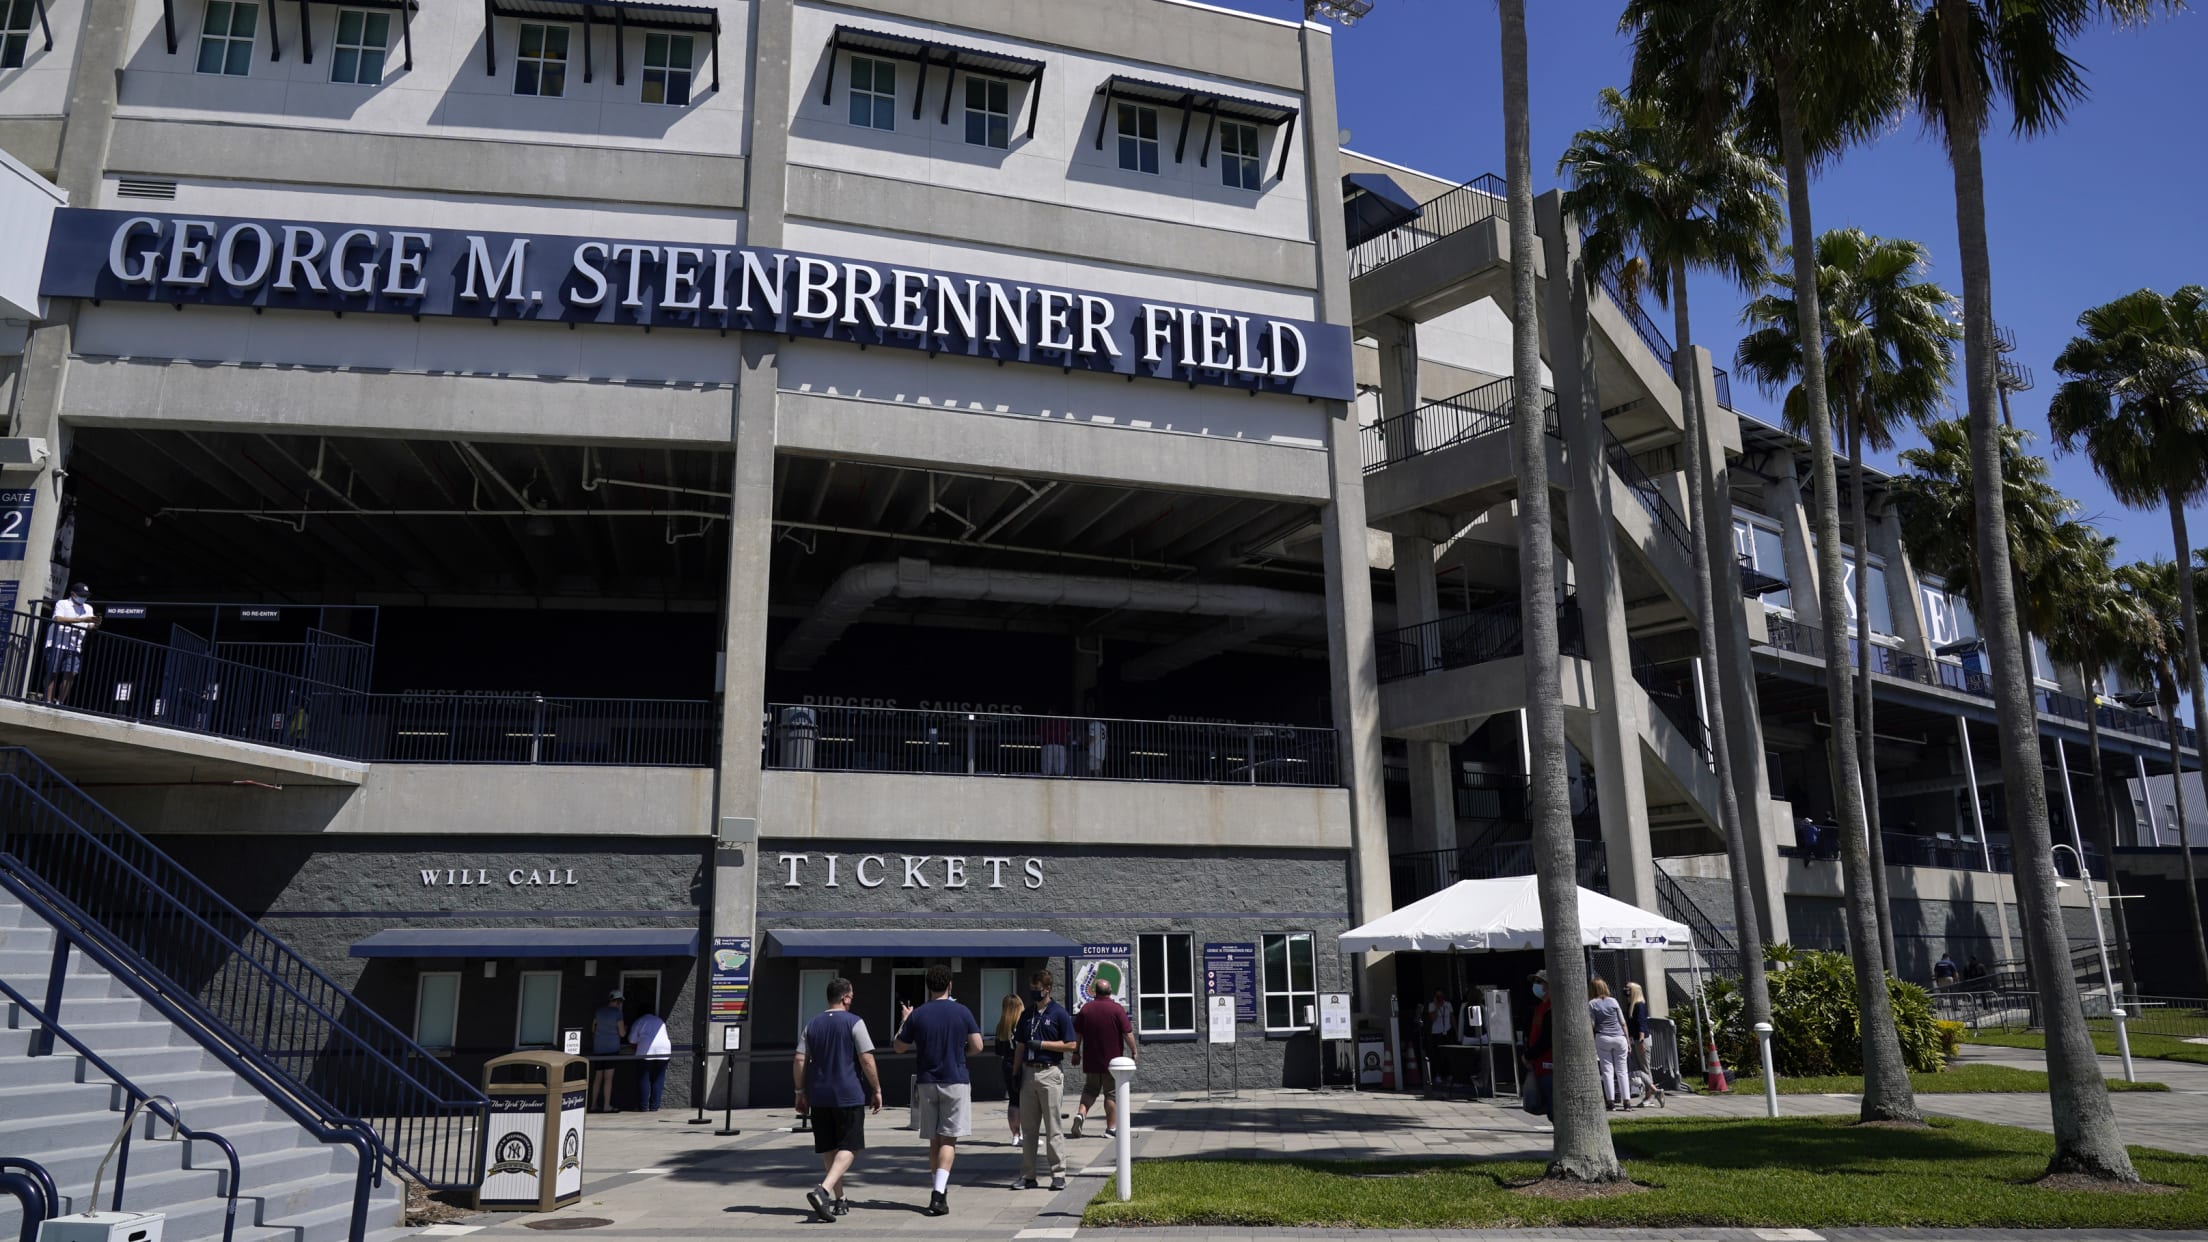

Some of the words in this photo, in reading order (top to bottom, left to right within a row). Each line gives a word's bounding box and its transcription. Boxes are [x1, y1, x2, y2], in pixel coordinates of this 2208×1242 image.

[109, 217, 433, 297] GEORGE
[460, 235, 543, 304] M.
[570, 242, 1122, 357] STEINBRENNER
[1141, 303, 1307, 377] FIELD
[1, 493, 31, 502] GATE
[0, 510, 22, 538] 2
[420, 869, 492, 885] WILL
[508, 869, 578, 885] CALL
[779, 854, 1044, 889] TICKETS
[1083, 946, 1110, 954] ECTORY
[503, 1099, 518, 1111] York
